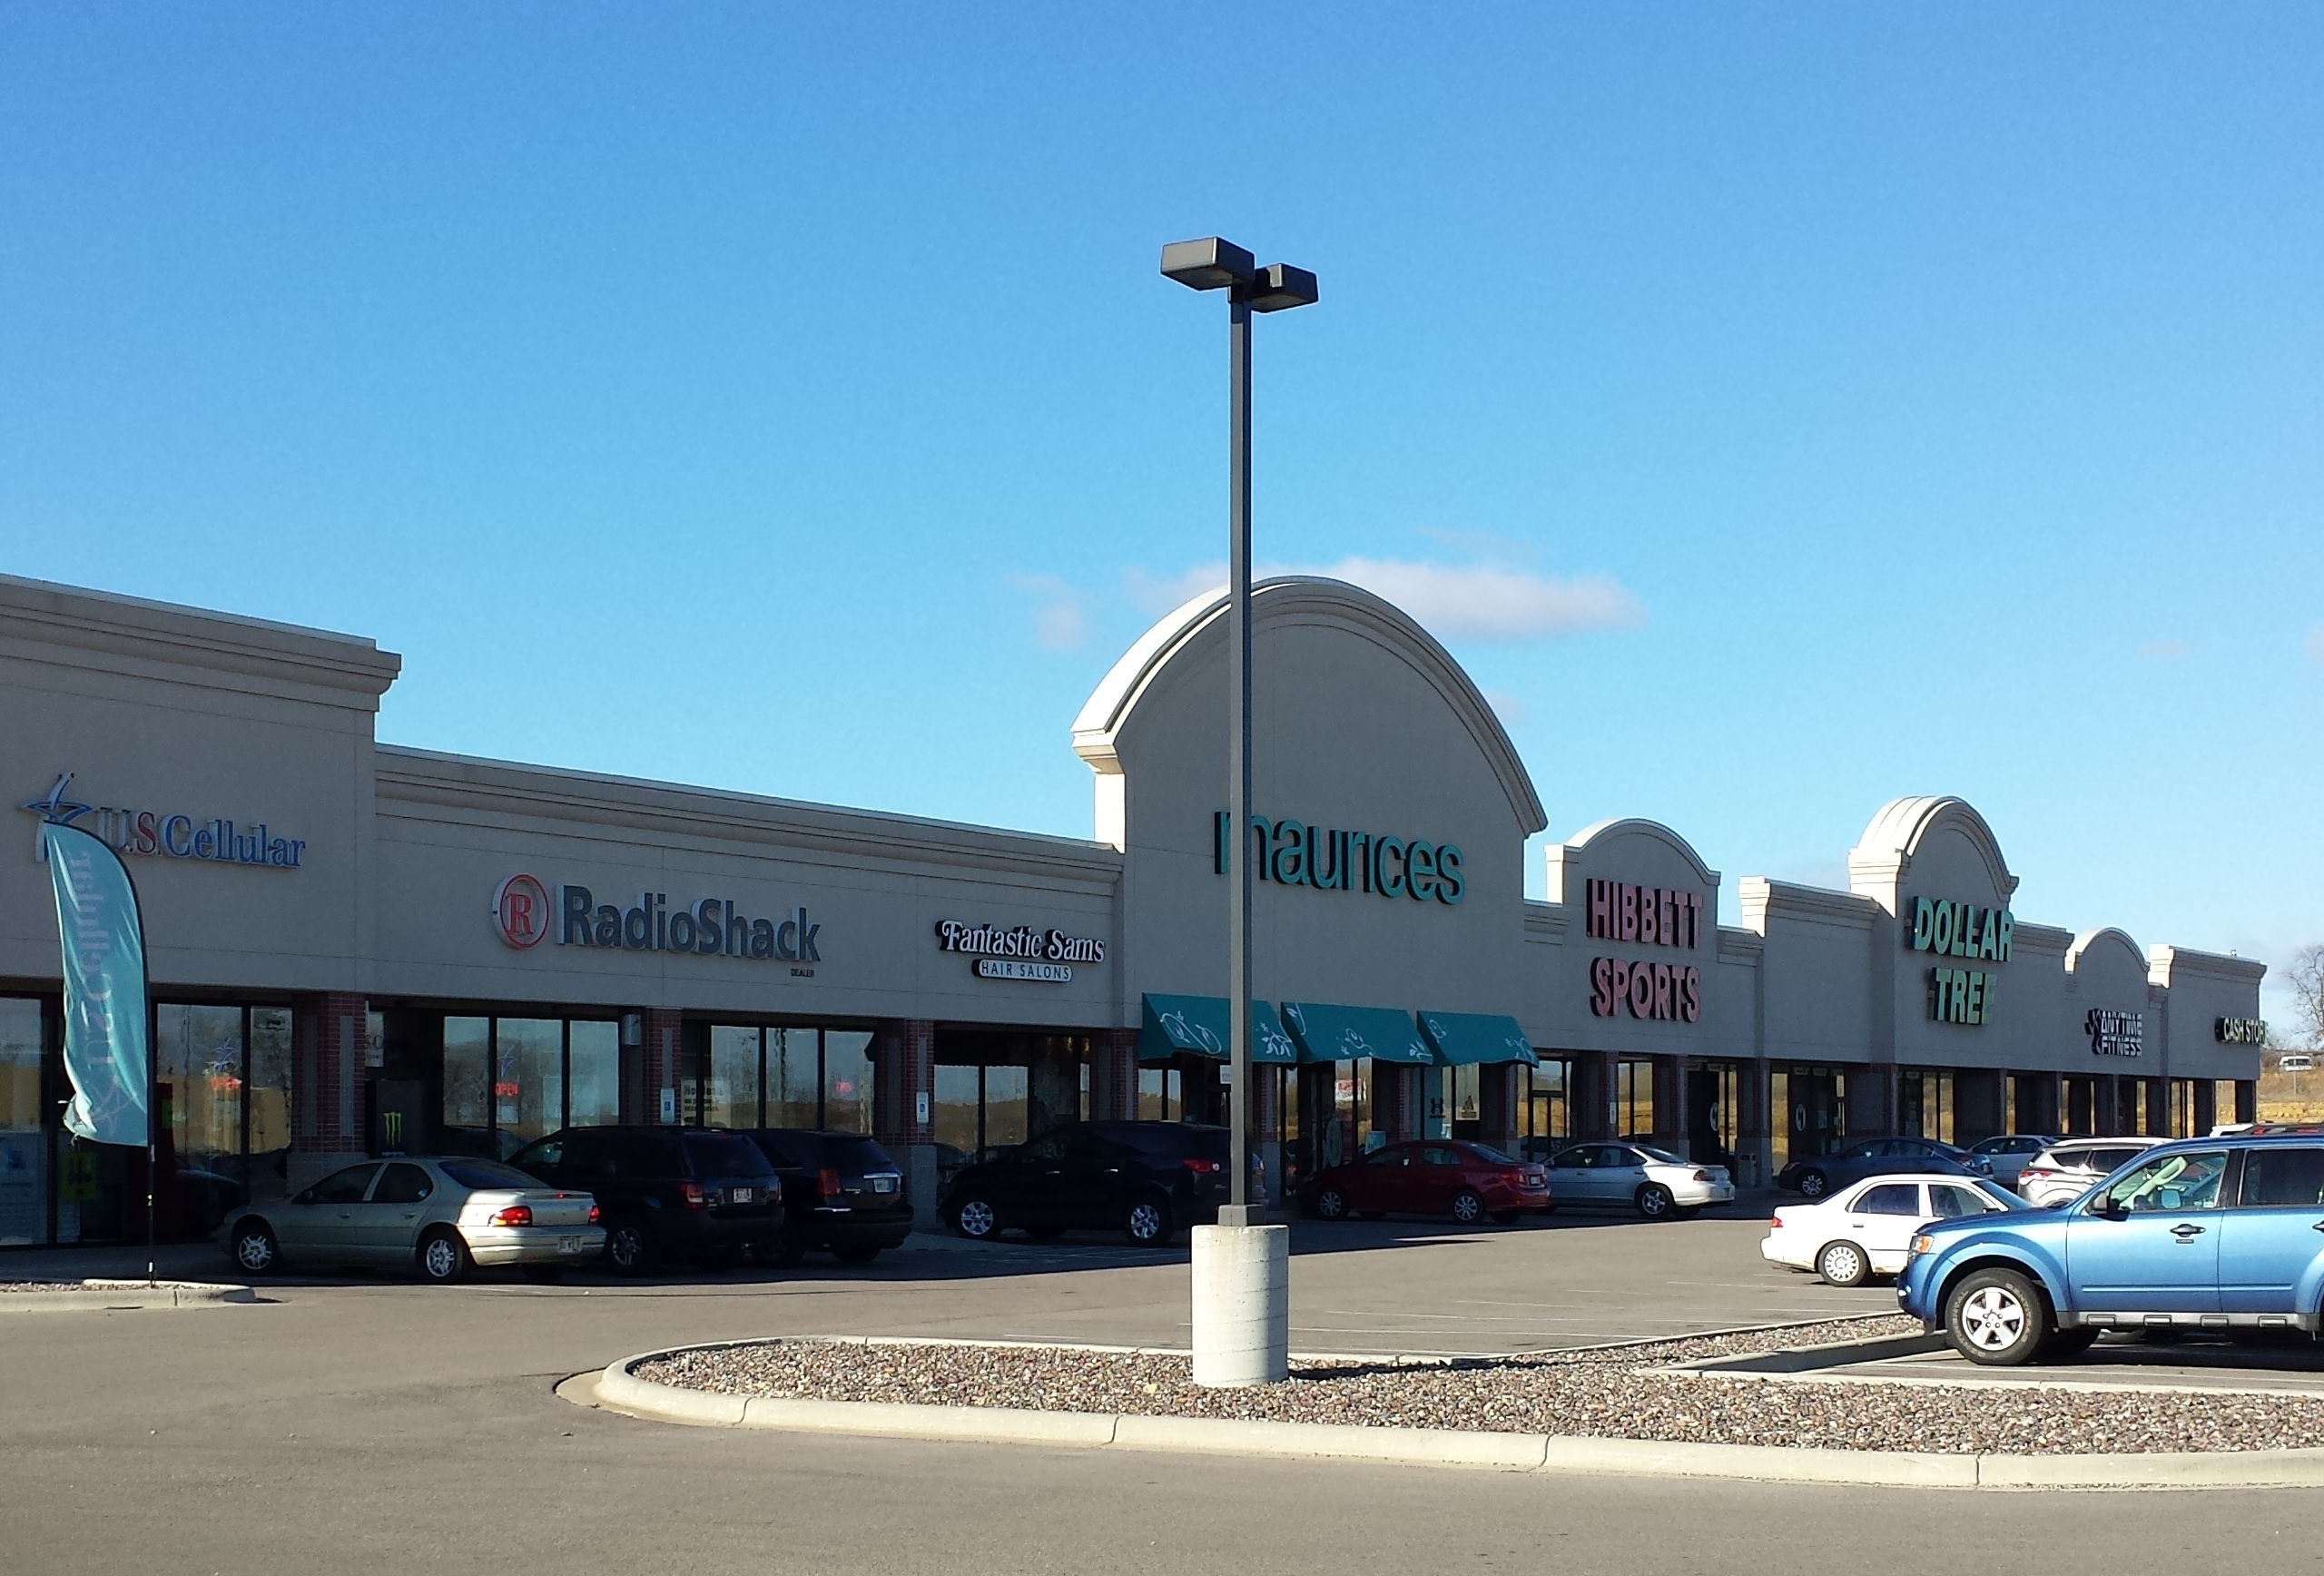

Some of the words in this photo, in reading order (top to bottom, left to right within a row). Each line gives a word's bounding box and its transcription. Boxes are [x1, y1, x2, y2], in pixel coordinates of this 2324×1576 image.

[1214, 811, 1465, 905] maurices
[556, 883, 822, 963] RadioShack
[935, 920, 1042, 959] Fantastic
[1043, 929, 1106, 963] Sams
[1586, 878, 1703, 950] HIBBETT
[1913, 896, 2015, 962] DOLLAR
[981, 961, 1013, 976] HAIR
[1019, 964, 1070, 980] SALONS
[1590, 957, 1702, 1023] SPORTS
[1932, 967, 1997, 1025] TREE
[2223, 1018, 2244, 1042] CASH
